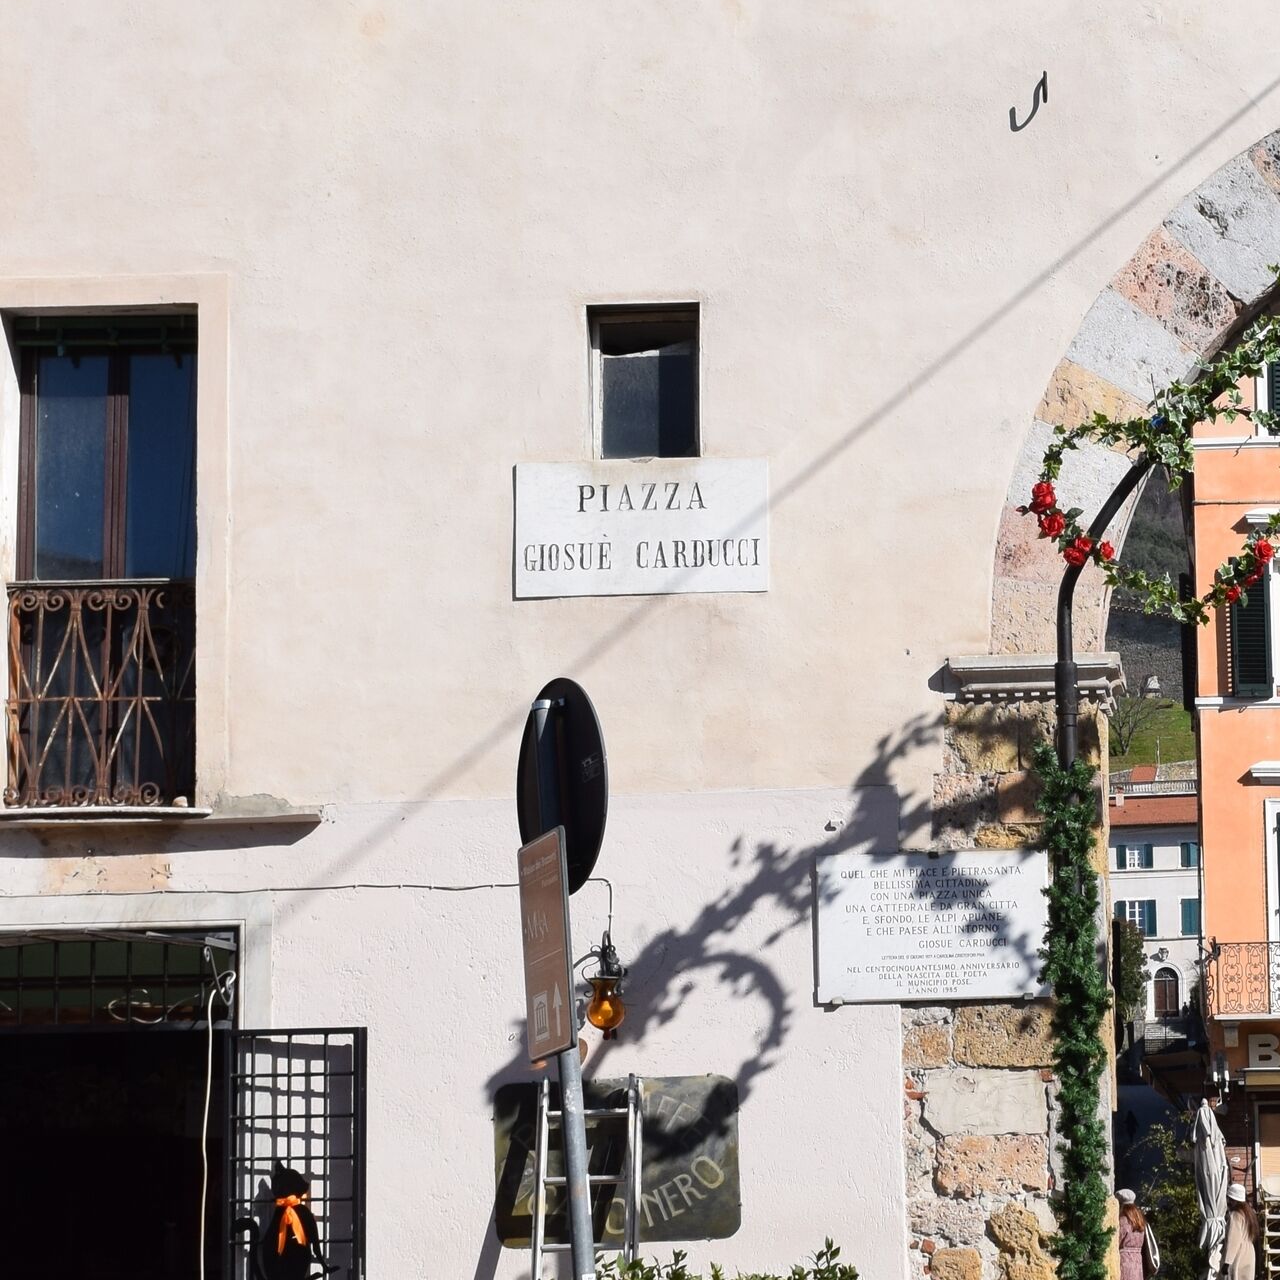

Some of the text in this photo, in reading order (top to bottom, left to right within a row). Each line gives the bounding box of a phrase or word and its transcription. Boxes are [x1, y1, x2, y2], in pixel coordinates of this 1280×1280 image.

[577, 482, 708, 513] PIAZZA
[523, 534, 761, 572] GIOSUÈ CARDUCCI
[840, 870, 865, 879] QUEL
[869, 869, 889, 878] CHE
[893, 868, 905, 878] MI
[909, 867, 937, 877] PIACE
[873, 880, 931, 889] BELLISSIMA
[870, 889, 992, 901] CON UNA PIAZZA UNICA
[845, 904, 866, 913] UNA
[870, 903, 936, 912] CATTEDRALE
[940, 902, 952, 911] DA
[957, 901, 985, 910] GRAN
[918, 914, 930, 923] LE
[934, 913, 957, 923] ALPI
[866, 927, 872, 936] E
[876, 927, 894, 936] CHE
[899, 926, 929, 935] PAESE
[959, 938, 1007, 948] CARDUCCI
[846, 966, 861, 974] NEL
[960, 961, 1020, 970] ANNIVERSARIO
[963, 970, 988, 978] POETA
[907, 979, 948, 987] MUNICIPIO
[640, 1154, 726, 1228] NERO
